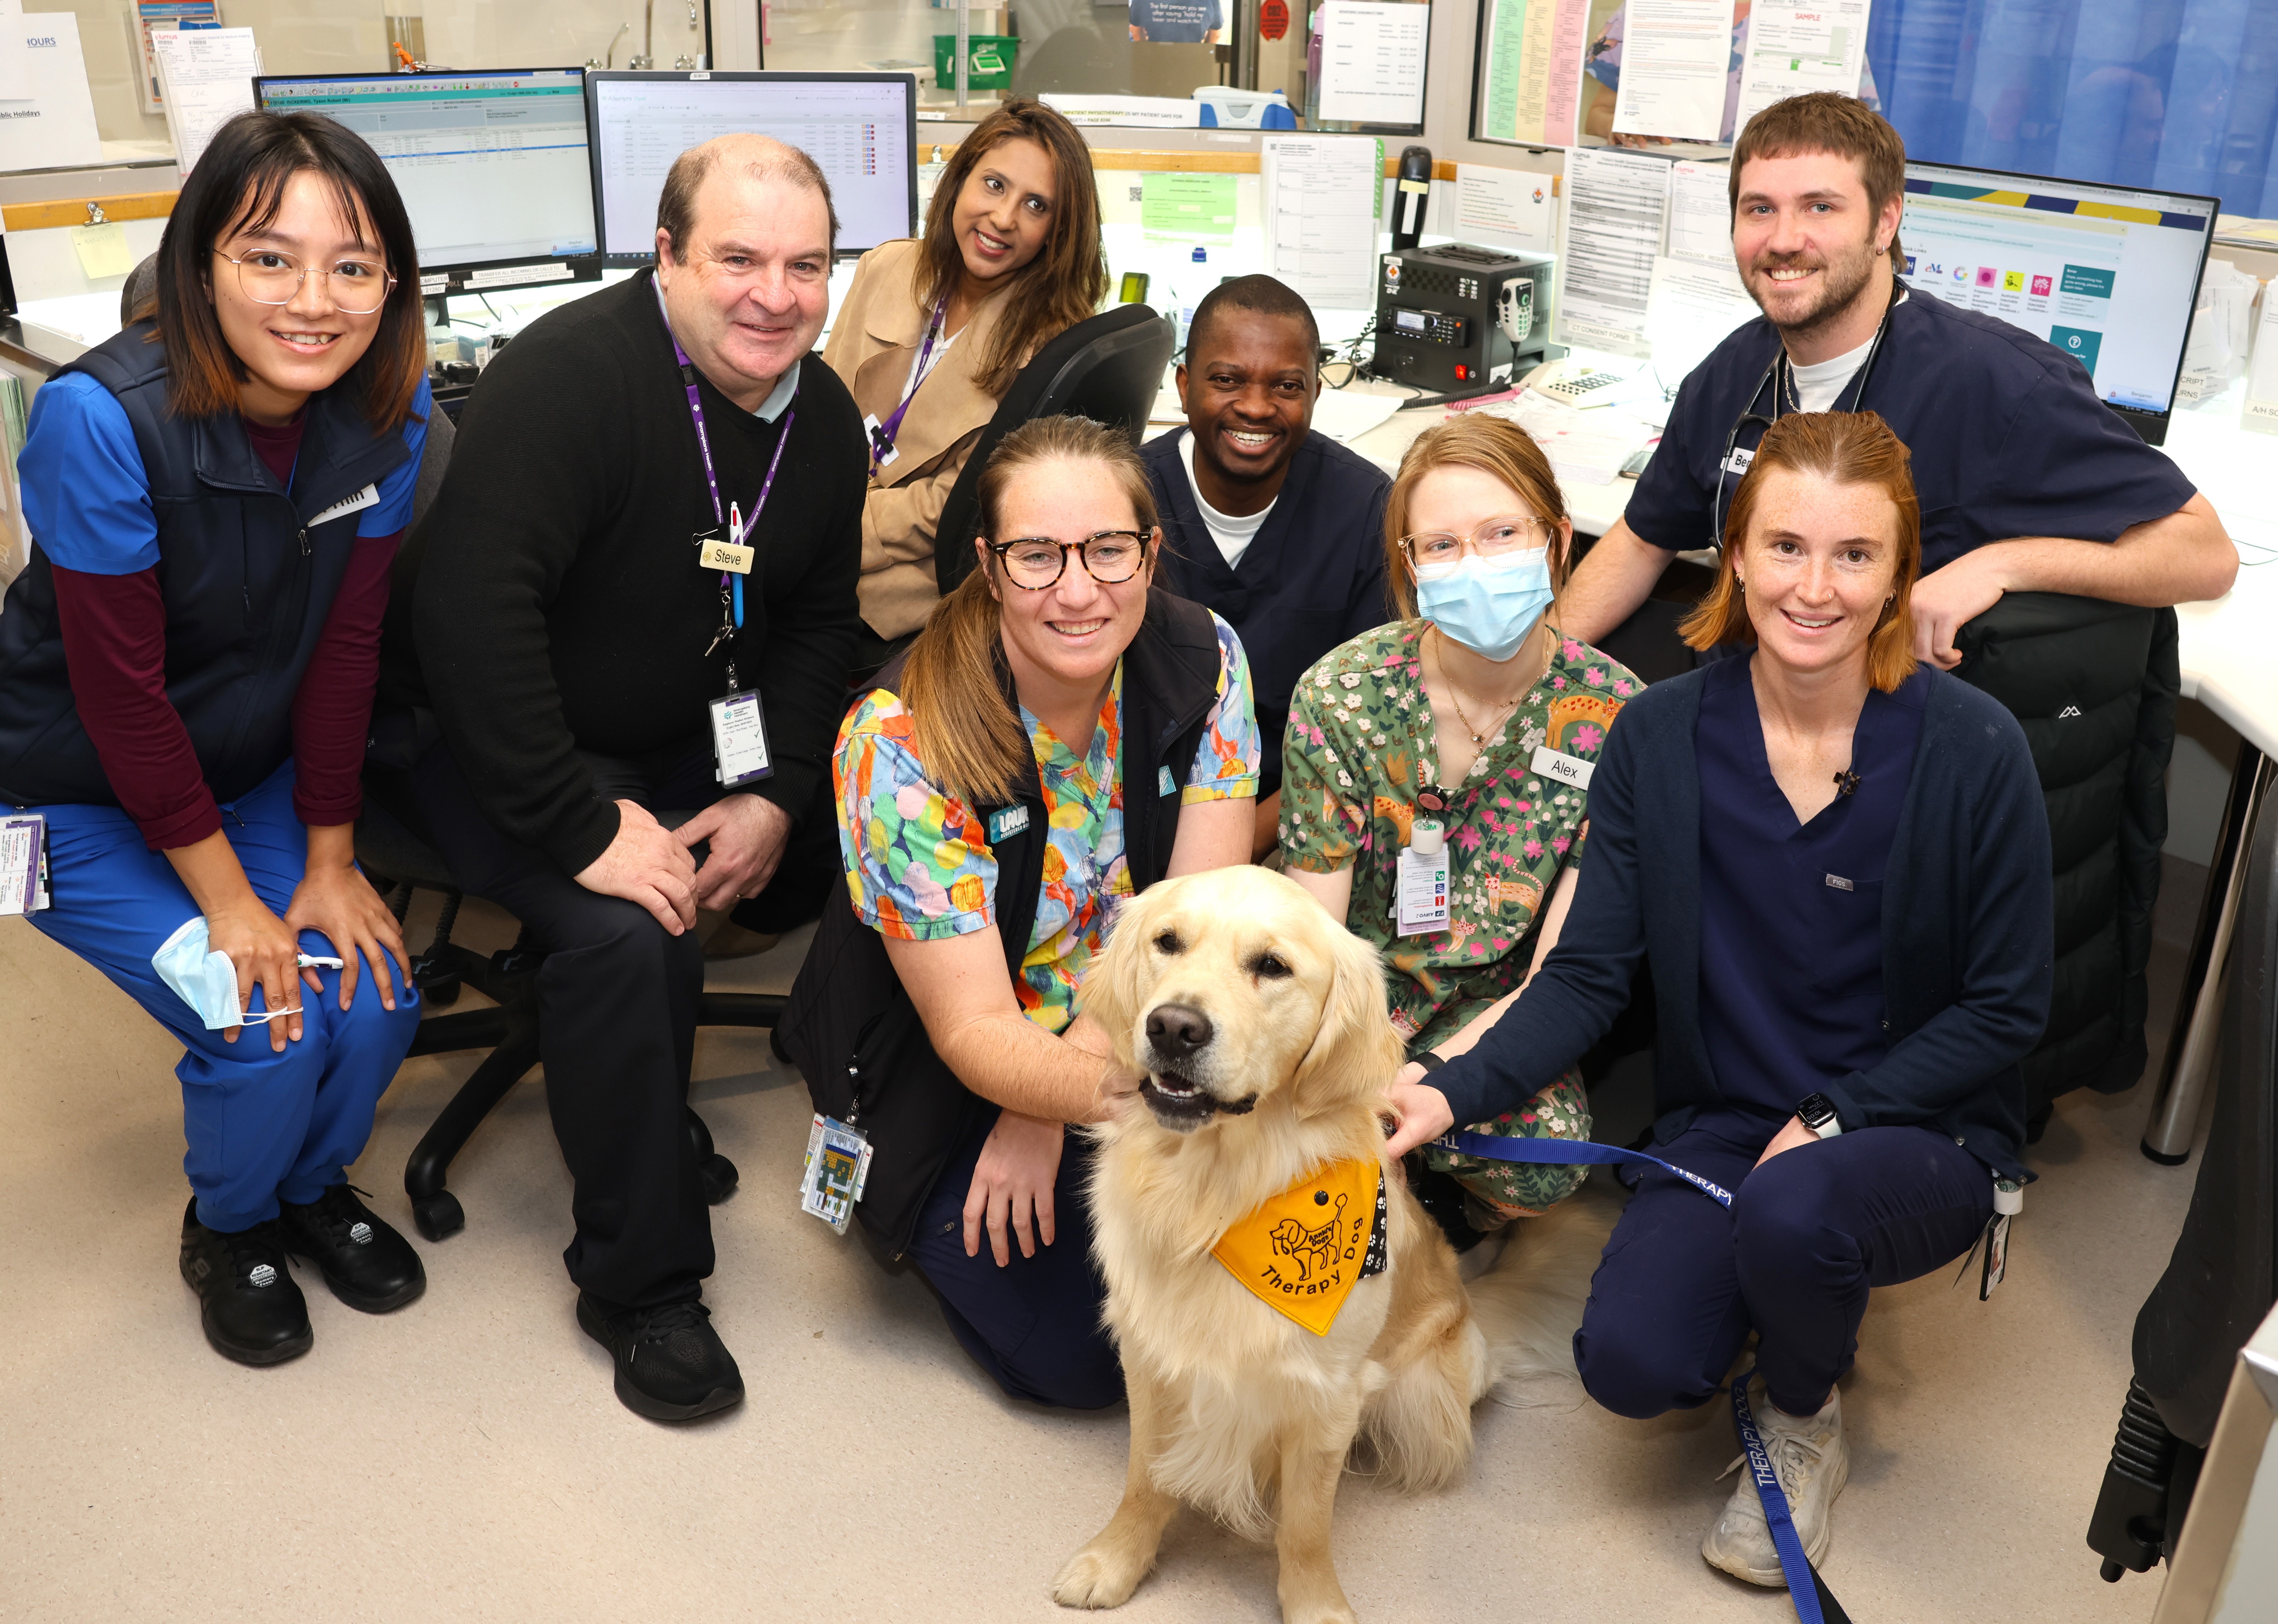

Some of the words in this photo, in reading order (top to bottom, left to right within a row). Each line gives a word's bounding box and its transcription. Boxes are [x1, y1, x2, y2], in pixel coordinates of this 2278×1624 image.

[1795, 13, 1821, 21] SAMPLE
[1675, 249, 1705, 259] RADIOLOGY
[1708, 254, 1732, 264] REQUEST
[1582, 326, 1608, 336] CONSENT
[1609, 331, 1630, 341] FORMS
[2180, 376, 2204, 386] CRIPT
[2252, 405, 2267, 415] A/H
[698, 421, 708, 453] Grampians
[772, 445, 784, 472] Grampians
[743, 512, 758, 537] Grampians
[757, 495, 766, 512] Health
[715, 549, 741, 565] Steve
[1552, 760, 1578, 779] Alex
[1001, 826, 1022, 838] REGISTERED
[356, 1233, 371, 1242] Memory
[1309, 1227, 1331, 1242] Annie's
[1312, 1235, 1329, 1247] Dogs
[1344, 1217, 1363, 1260] Dog
[252, 1268, 272, 1278] RESISTANT
[255, 1276, 274, 1284] Memory
[1261, 1265, 1340, 1296] Therapy
[1734, 1386, 1749, 1421] DOG
[1742, 1424, 1777, 1486] THERAPY
